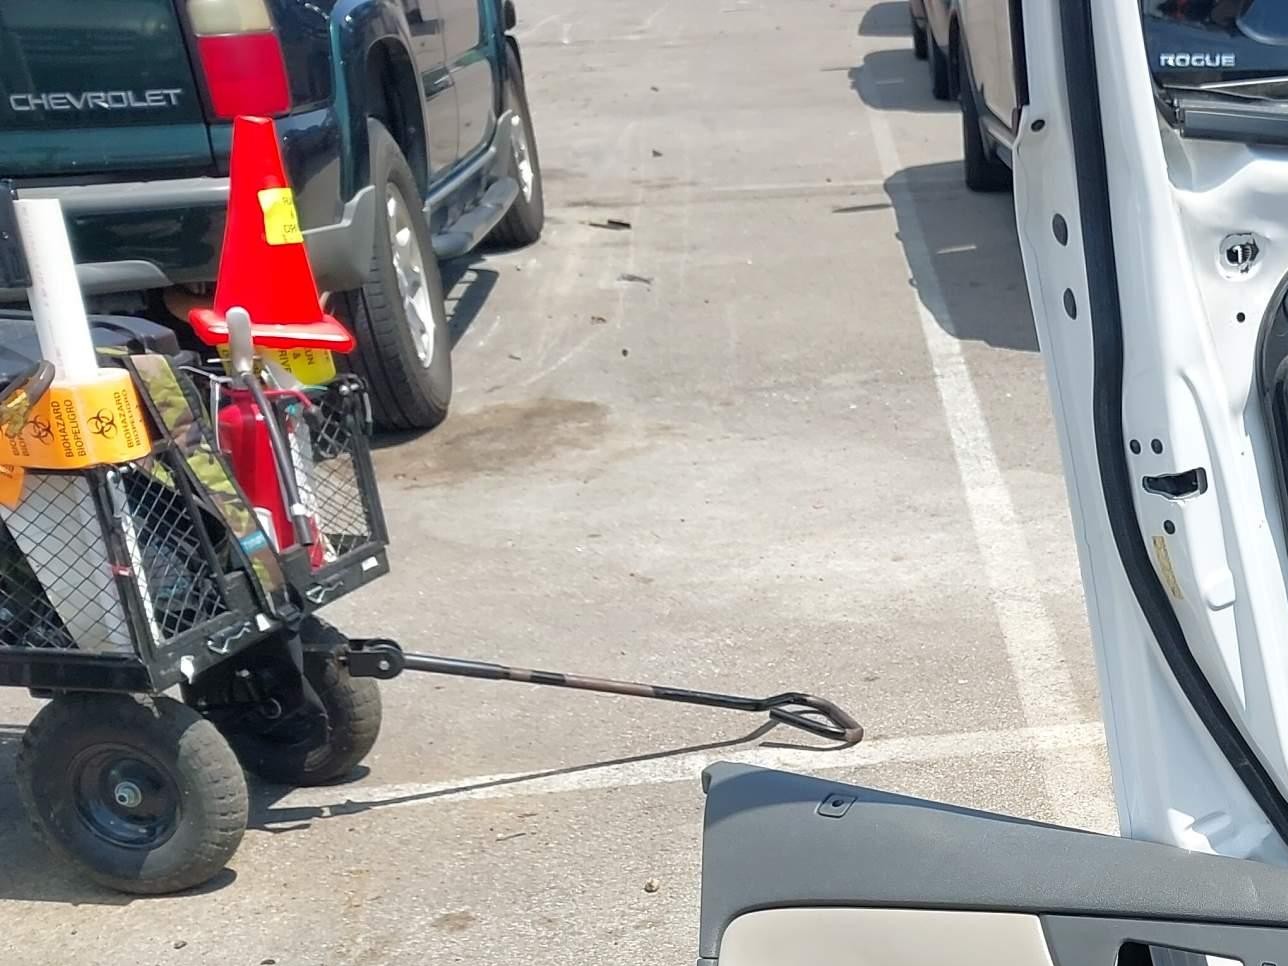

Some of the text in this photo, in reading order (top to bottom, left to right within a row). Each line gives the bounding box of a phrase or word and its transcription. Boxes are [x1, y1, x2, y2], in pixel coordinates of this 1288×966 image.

[1160, 52, 1236, 67] ROGUE
[9, 88, 182, 111] CHEVROLET
[51, 400, 75, 458] BIOHAZARD
[63, 399, 87, 458] BIOPELIGRO
[113, 391, 135, 449] BIOHAZARD
